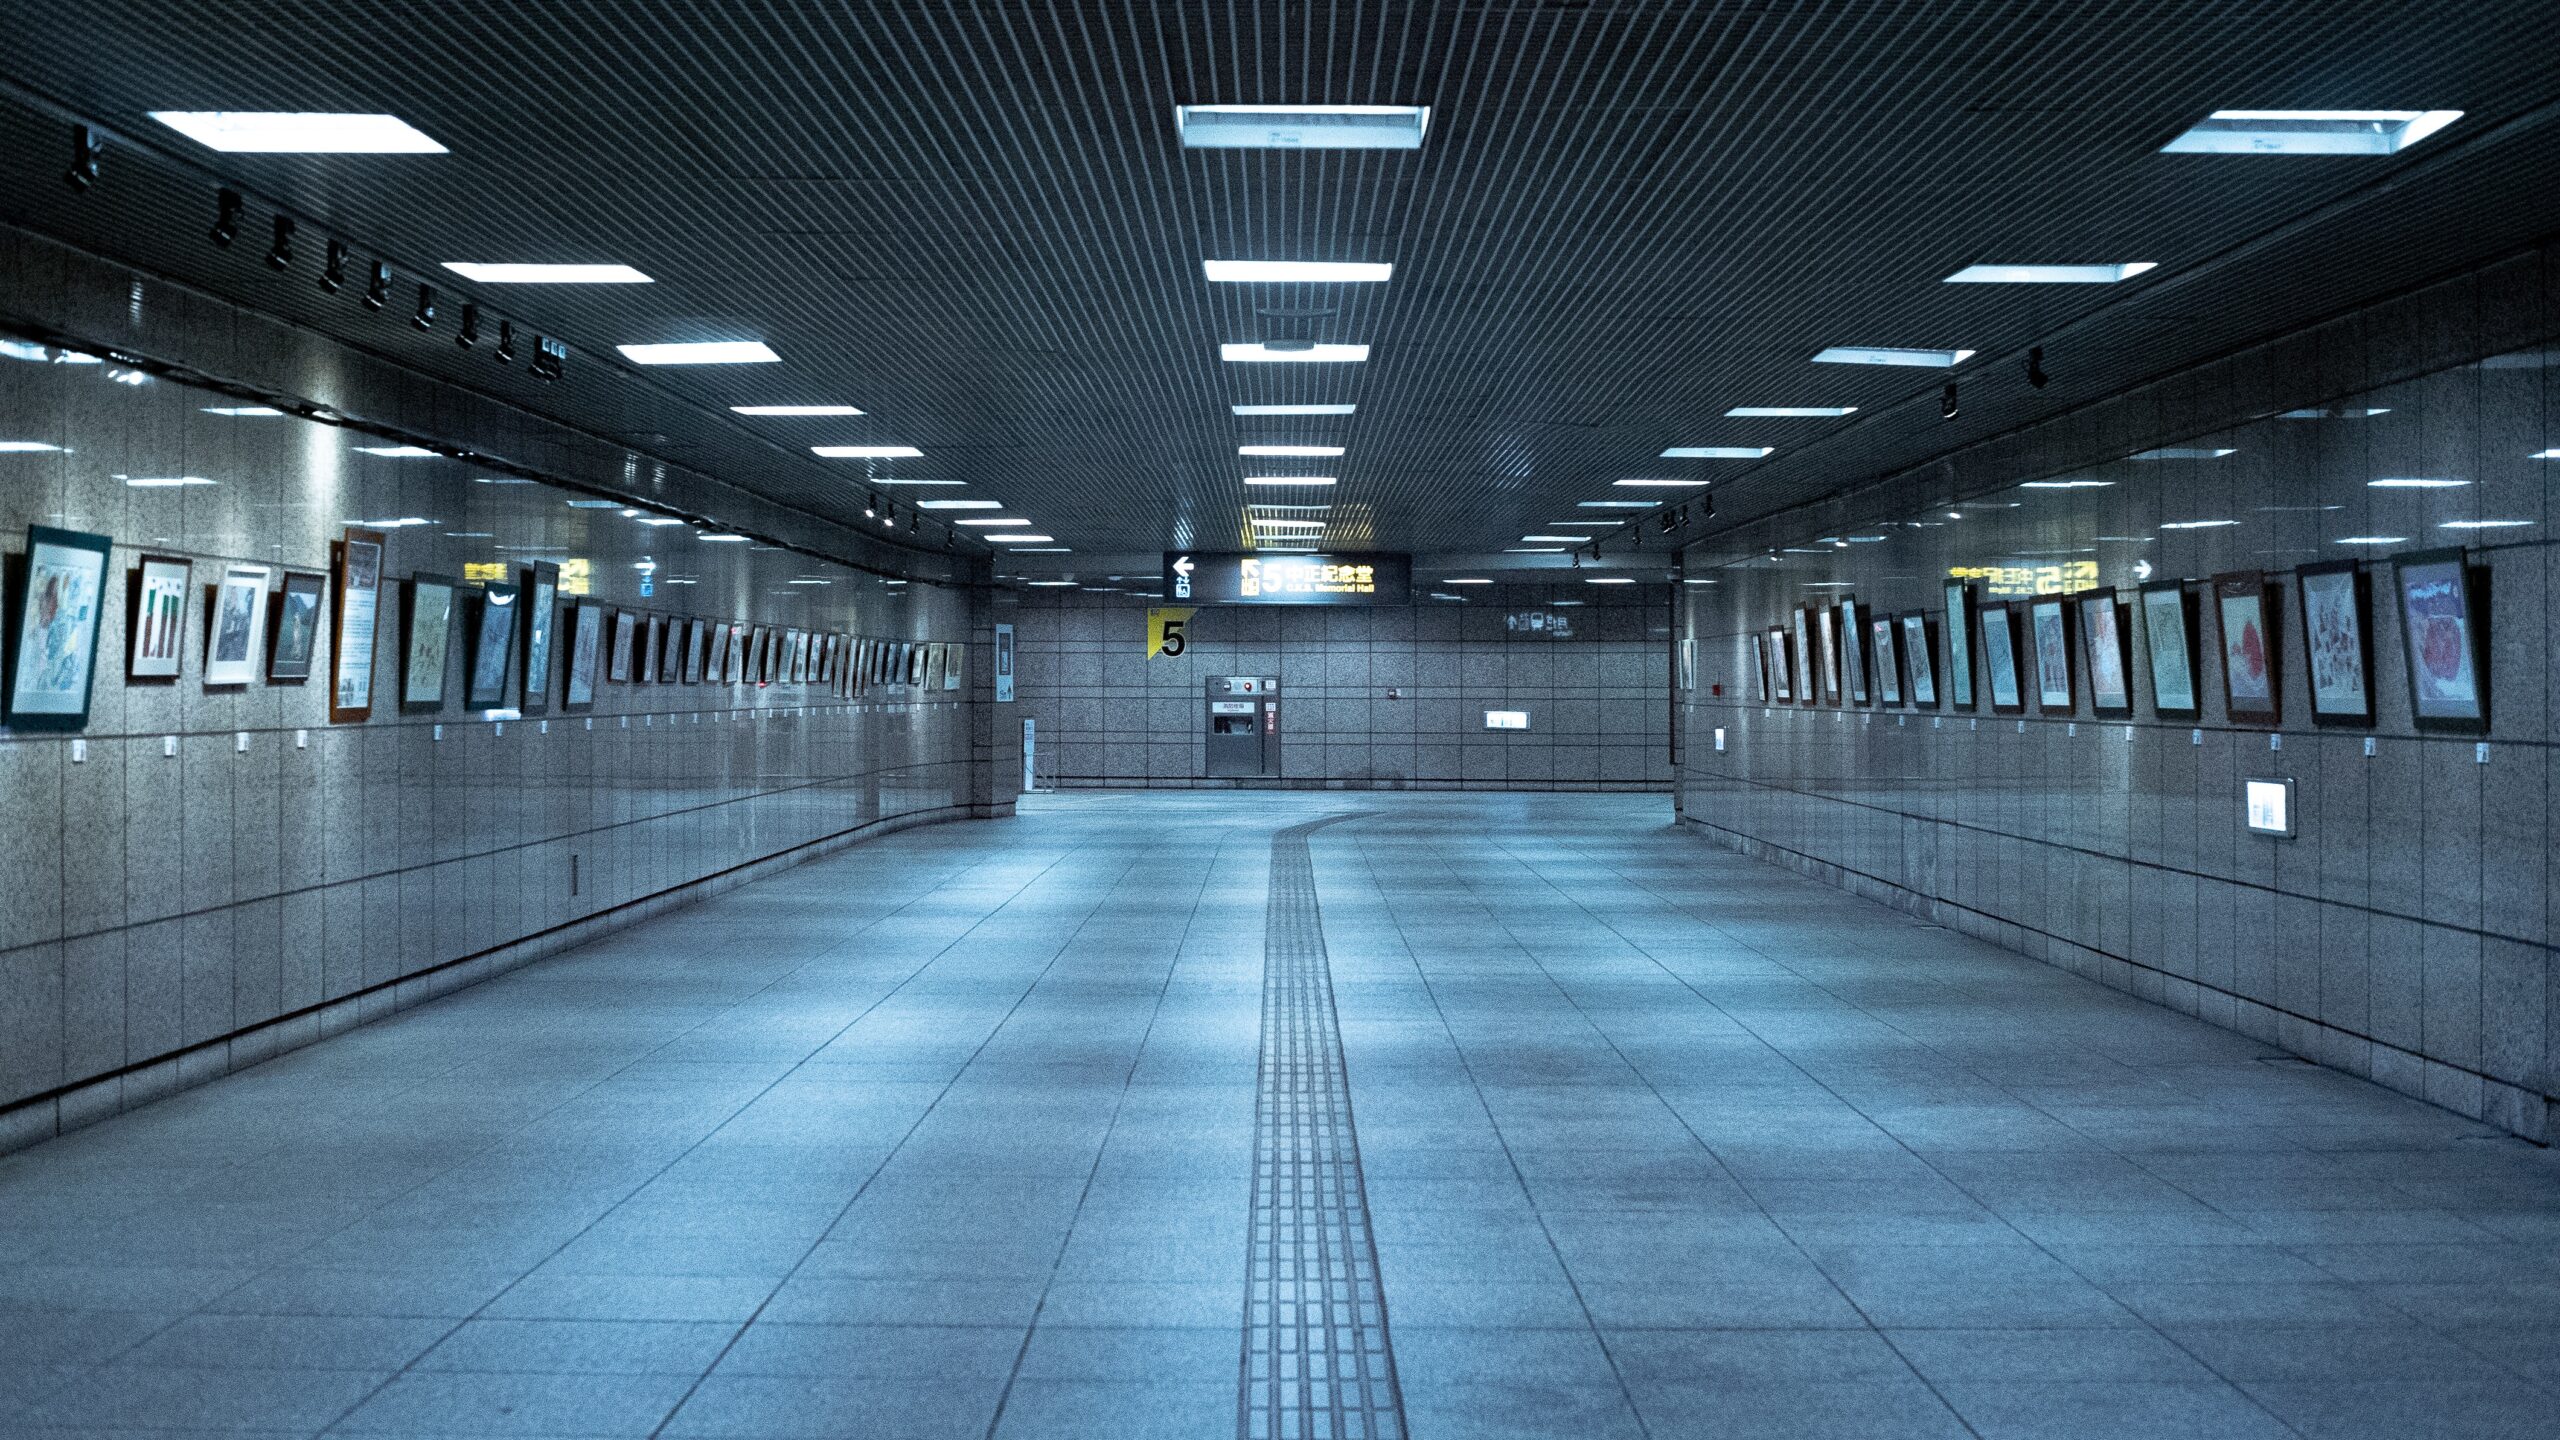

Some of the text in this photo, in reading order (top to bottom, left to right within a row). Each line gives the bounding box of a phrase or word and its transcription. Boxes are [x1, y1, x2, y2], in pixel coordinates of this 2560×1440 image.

[1262, 564, 1282, 592] 5
[1286, 565, 1373, 582] 中正紀念堂
[1315, 584, 1355, 592] Memorial
[1357, 584, 1374, 592] Hall
[1161, 620, 1186, 657] 5
